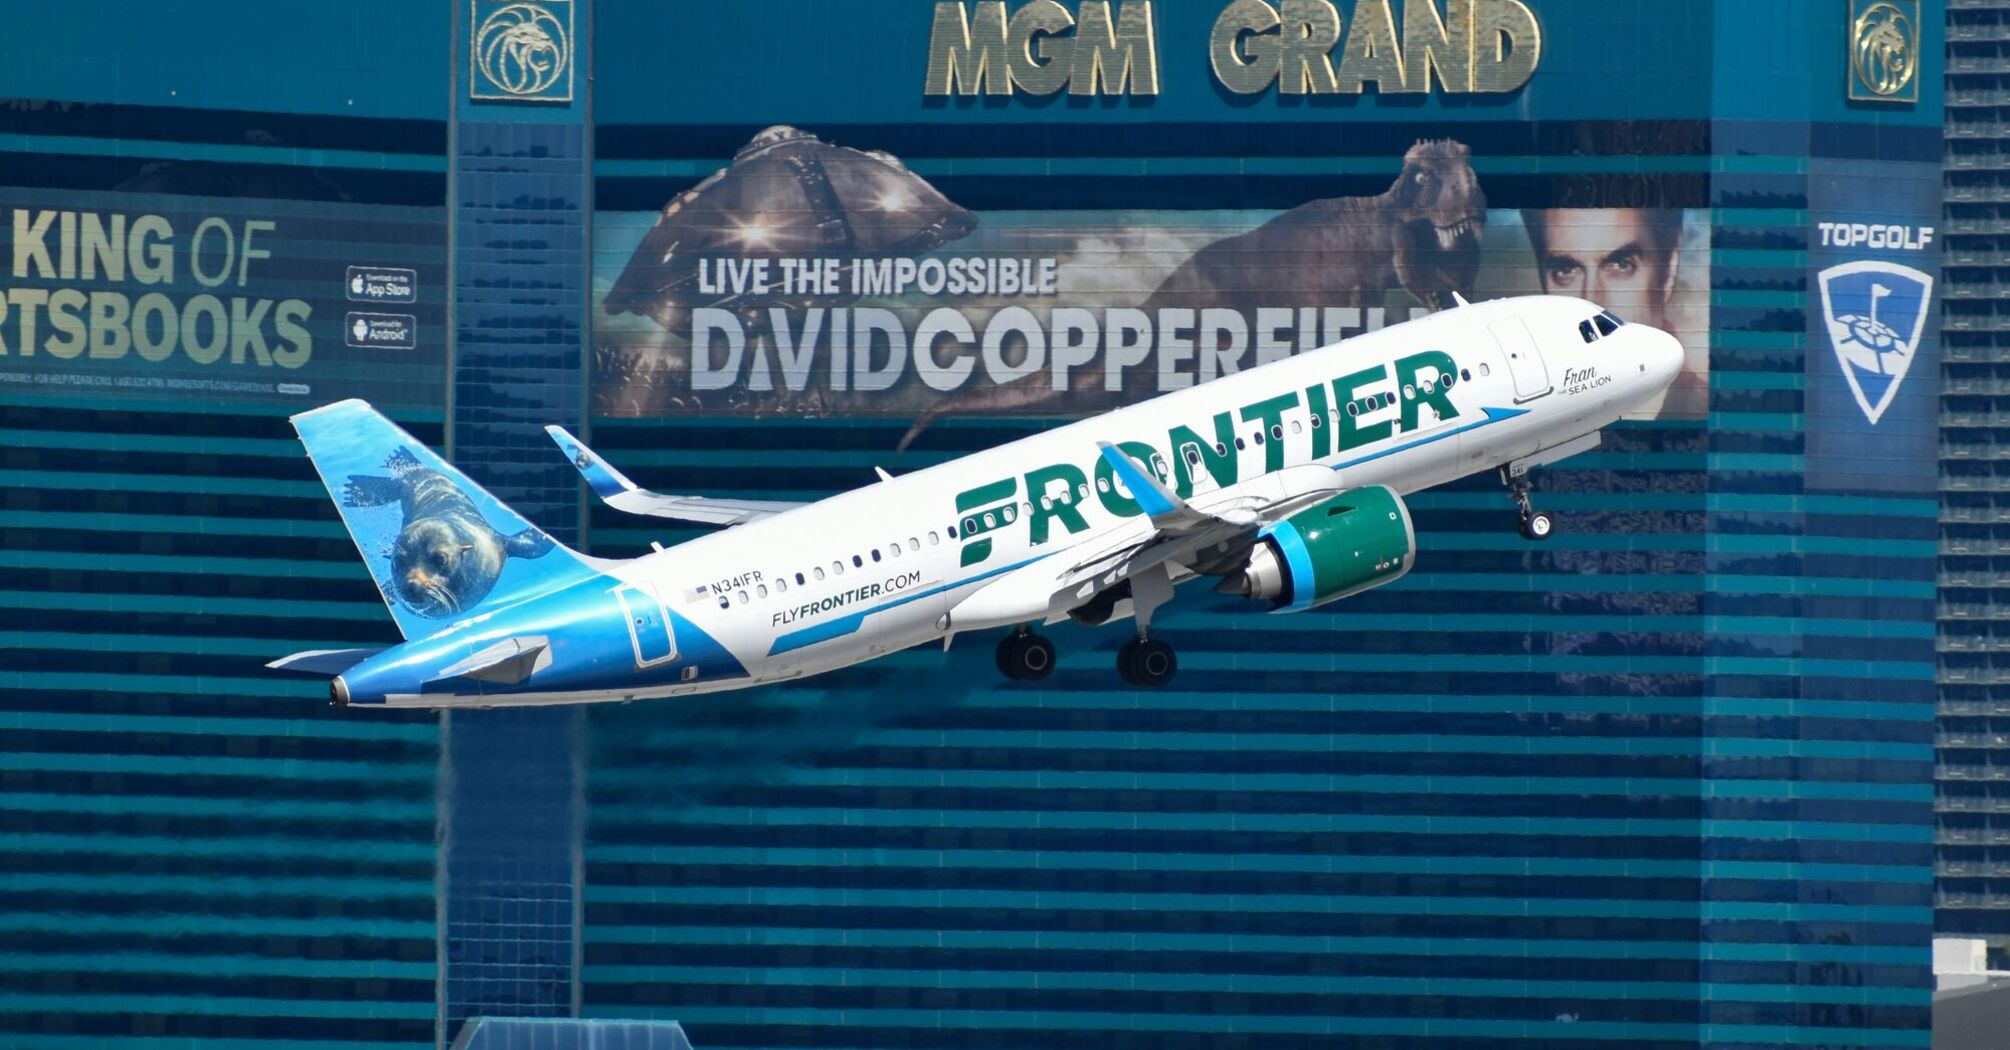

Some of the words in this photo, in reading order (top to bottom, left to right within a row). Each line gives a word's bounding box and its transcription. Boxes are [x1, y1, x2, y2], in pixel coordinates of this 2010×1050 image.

[924, 0, 1160, 96] MGM
[1209, 0, 1542, 96] GRAND
[12, 209, 175, 285] KING
[190, 216, 276, 287] OF
[1818, 222, 1934, 250] TOPGOLF
[365, 282, 385, 297] App
[386, 282, 411, 296] Store
[697, 257, 769, 294] LIVE
[780, 257, 840, 295] THE
[852, 257, 1057, 296] IMPOSSIBLE
[0, 288, 313, 369] TSBOOKS
[1563, 366, 1597, 387] Fran
[1568, 383, 1587, 395] SEA
[1590, 375, 1612, 389] LION
[955, 349, 1460, 568] FRONTIER
[711, 570, 763, 595] N341FR
[772, 570, 921, 628] FLYFRONTIER.COM
